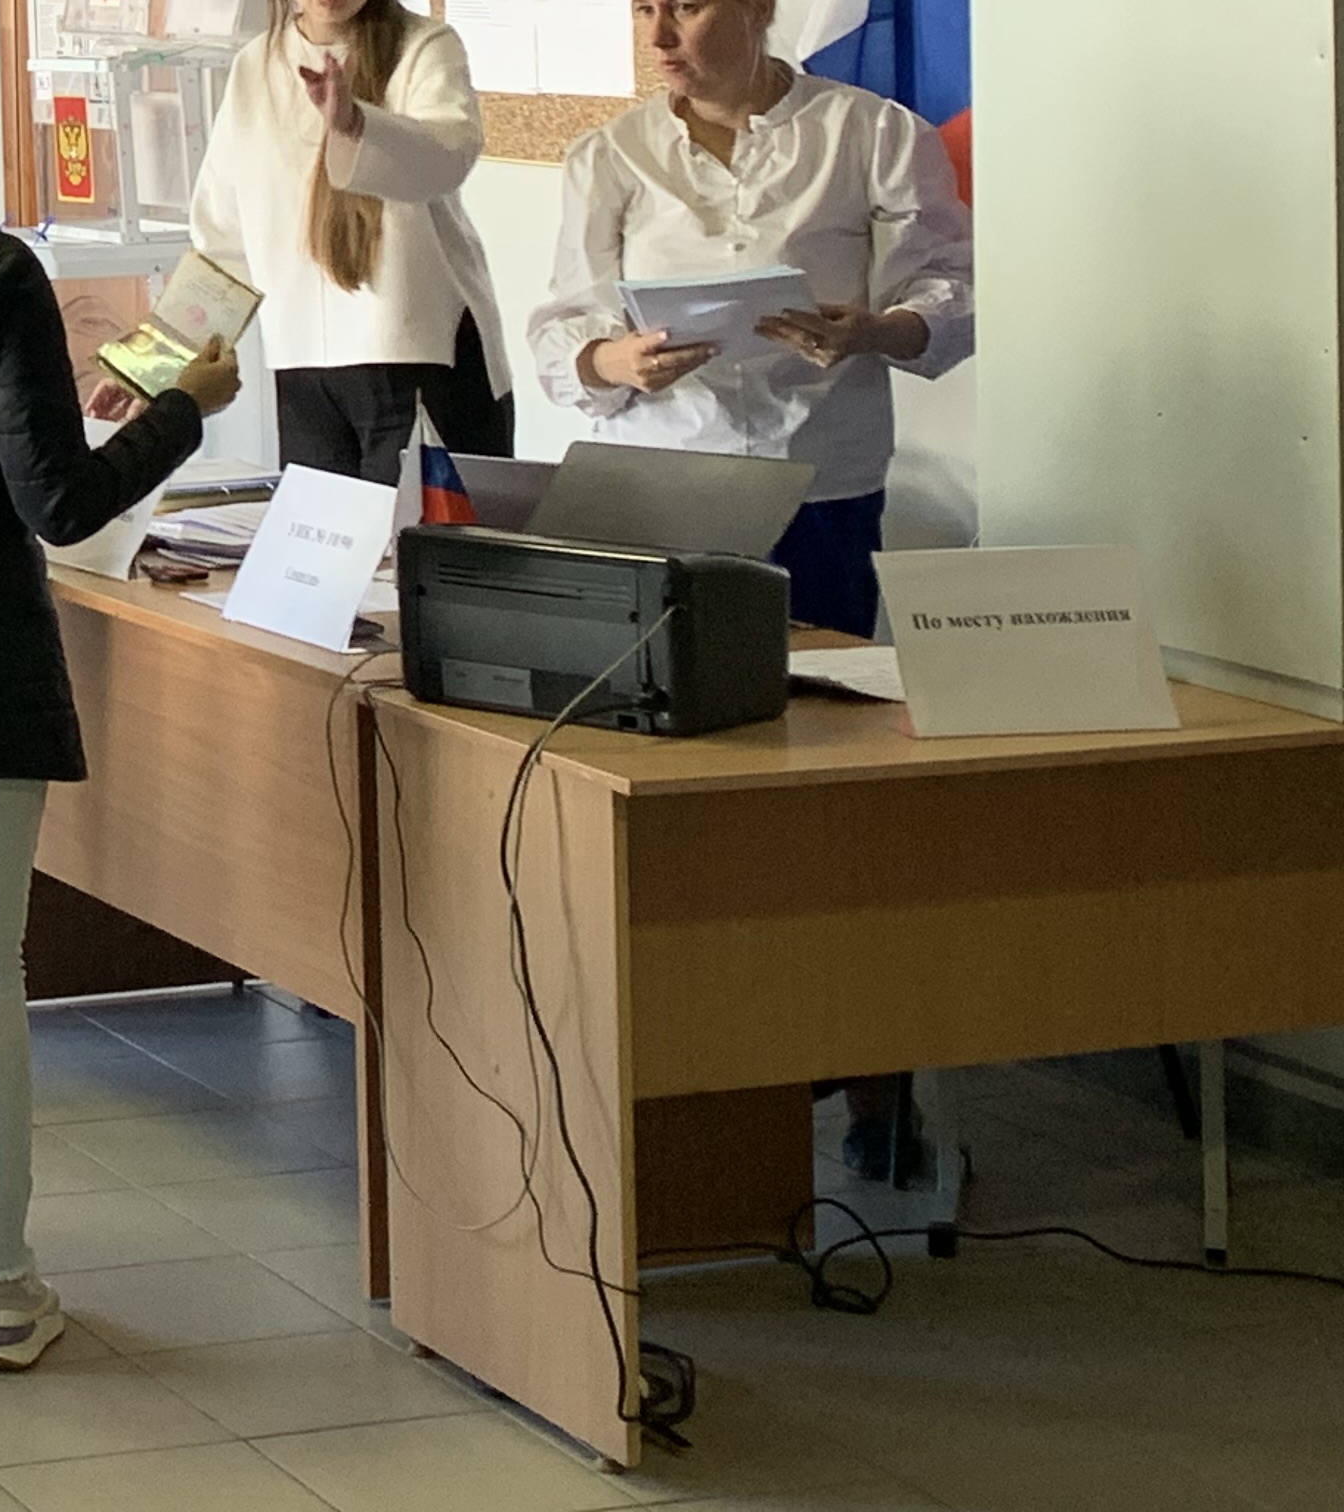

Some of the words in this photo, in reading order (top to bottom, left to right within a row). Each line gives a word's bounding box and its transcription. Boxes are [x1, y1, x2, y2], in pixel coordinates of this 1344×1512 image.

[912, 613, 942, 630] По
[946, 614, 1004, 631] месту
[1010, 608, 1131, 626] нахождения
